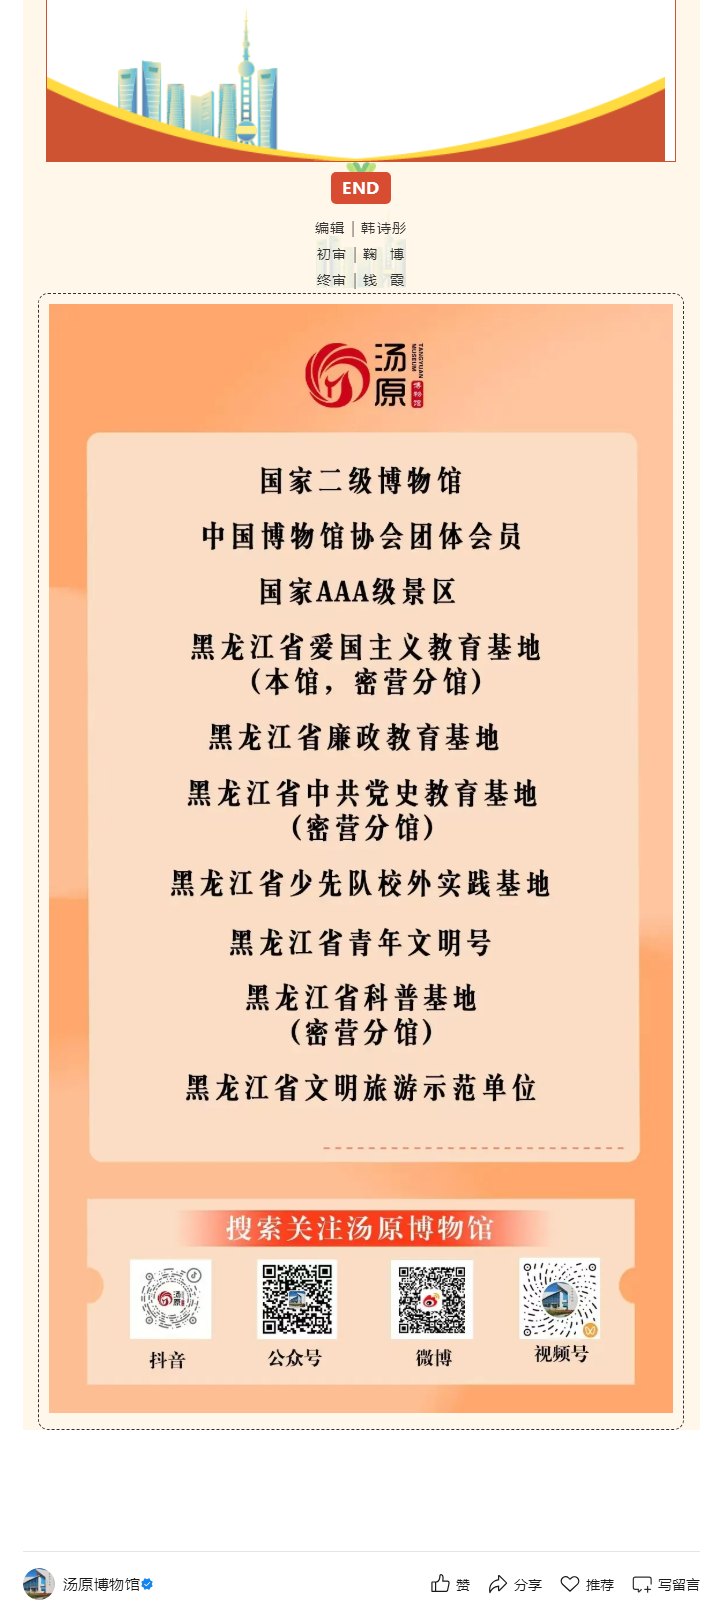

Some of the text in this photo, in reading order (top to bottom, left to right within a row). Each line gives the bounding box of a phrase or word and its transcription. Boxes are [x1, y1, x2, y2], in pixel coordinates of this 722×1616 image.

[343, 181, 380, 195] END
[315, 221, 345, 235] 编辑
[360, 221, 407, 235] 韩诗彤
[316, 247, 346, 261] 初审
[316, 273, 346, 287] 终审
[261, 466, 462, 495] 国家二级博物馆
[203, 522, 521, 551] 中国博物馆协会团体会员
[261, 577, 456, 606] 国家AAA级景区
[191, 633, 541, 662] 黑龙江省爱国主义教育基地
[209, 723, 499, 752] 黑龙江省廉政教育基地
[188, 779, 538, 808] 黑龙江省中共党史教育基地
[171, 869, 550, 898] 黑龙江省少先队校外实践基地
[230, 928, 491, 957] 黑龙江省青年文明号
[246, 983, 477, 1012] 黑龙江省科普基地
[186, 1073, 536, 1102] 黑龙江省文明旅游示范单位
[226, 1213, 495, 1244] 搜索关注汤原博物馆
[149, 1351, 186, 1370] 抖音
[268, 1348, 323, 1368] 公众号
[416, 1348, 453, 1367] 微博
[534, 1344, 590, 1364] 视频号
[63, 1577, 141, 1592] 汤原博物馆
[456, 1578, 471, 1593] 赞
[514, 1578, 543, 1593] 分享
[585, 1578, 615, 1593] 推荐
[658, 1578, 701, 1593] 写留言
